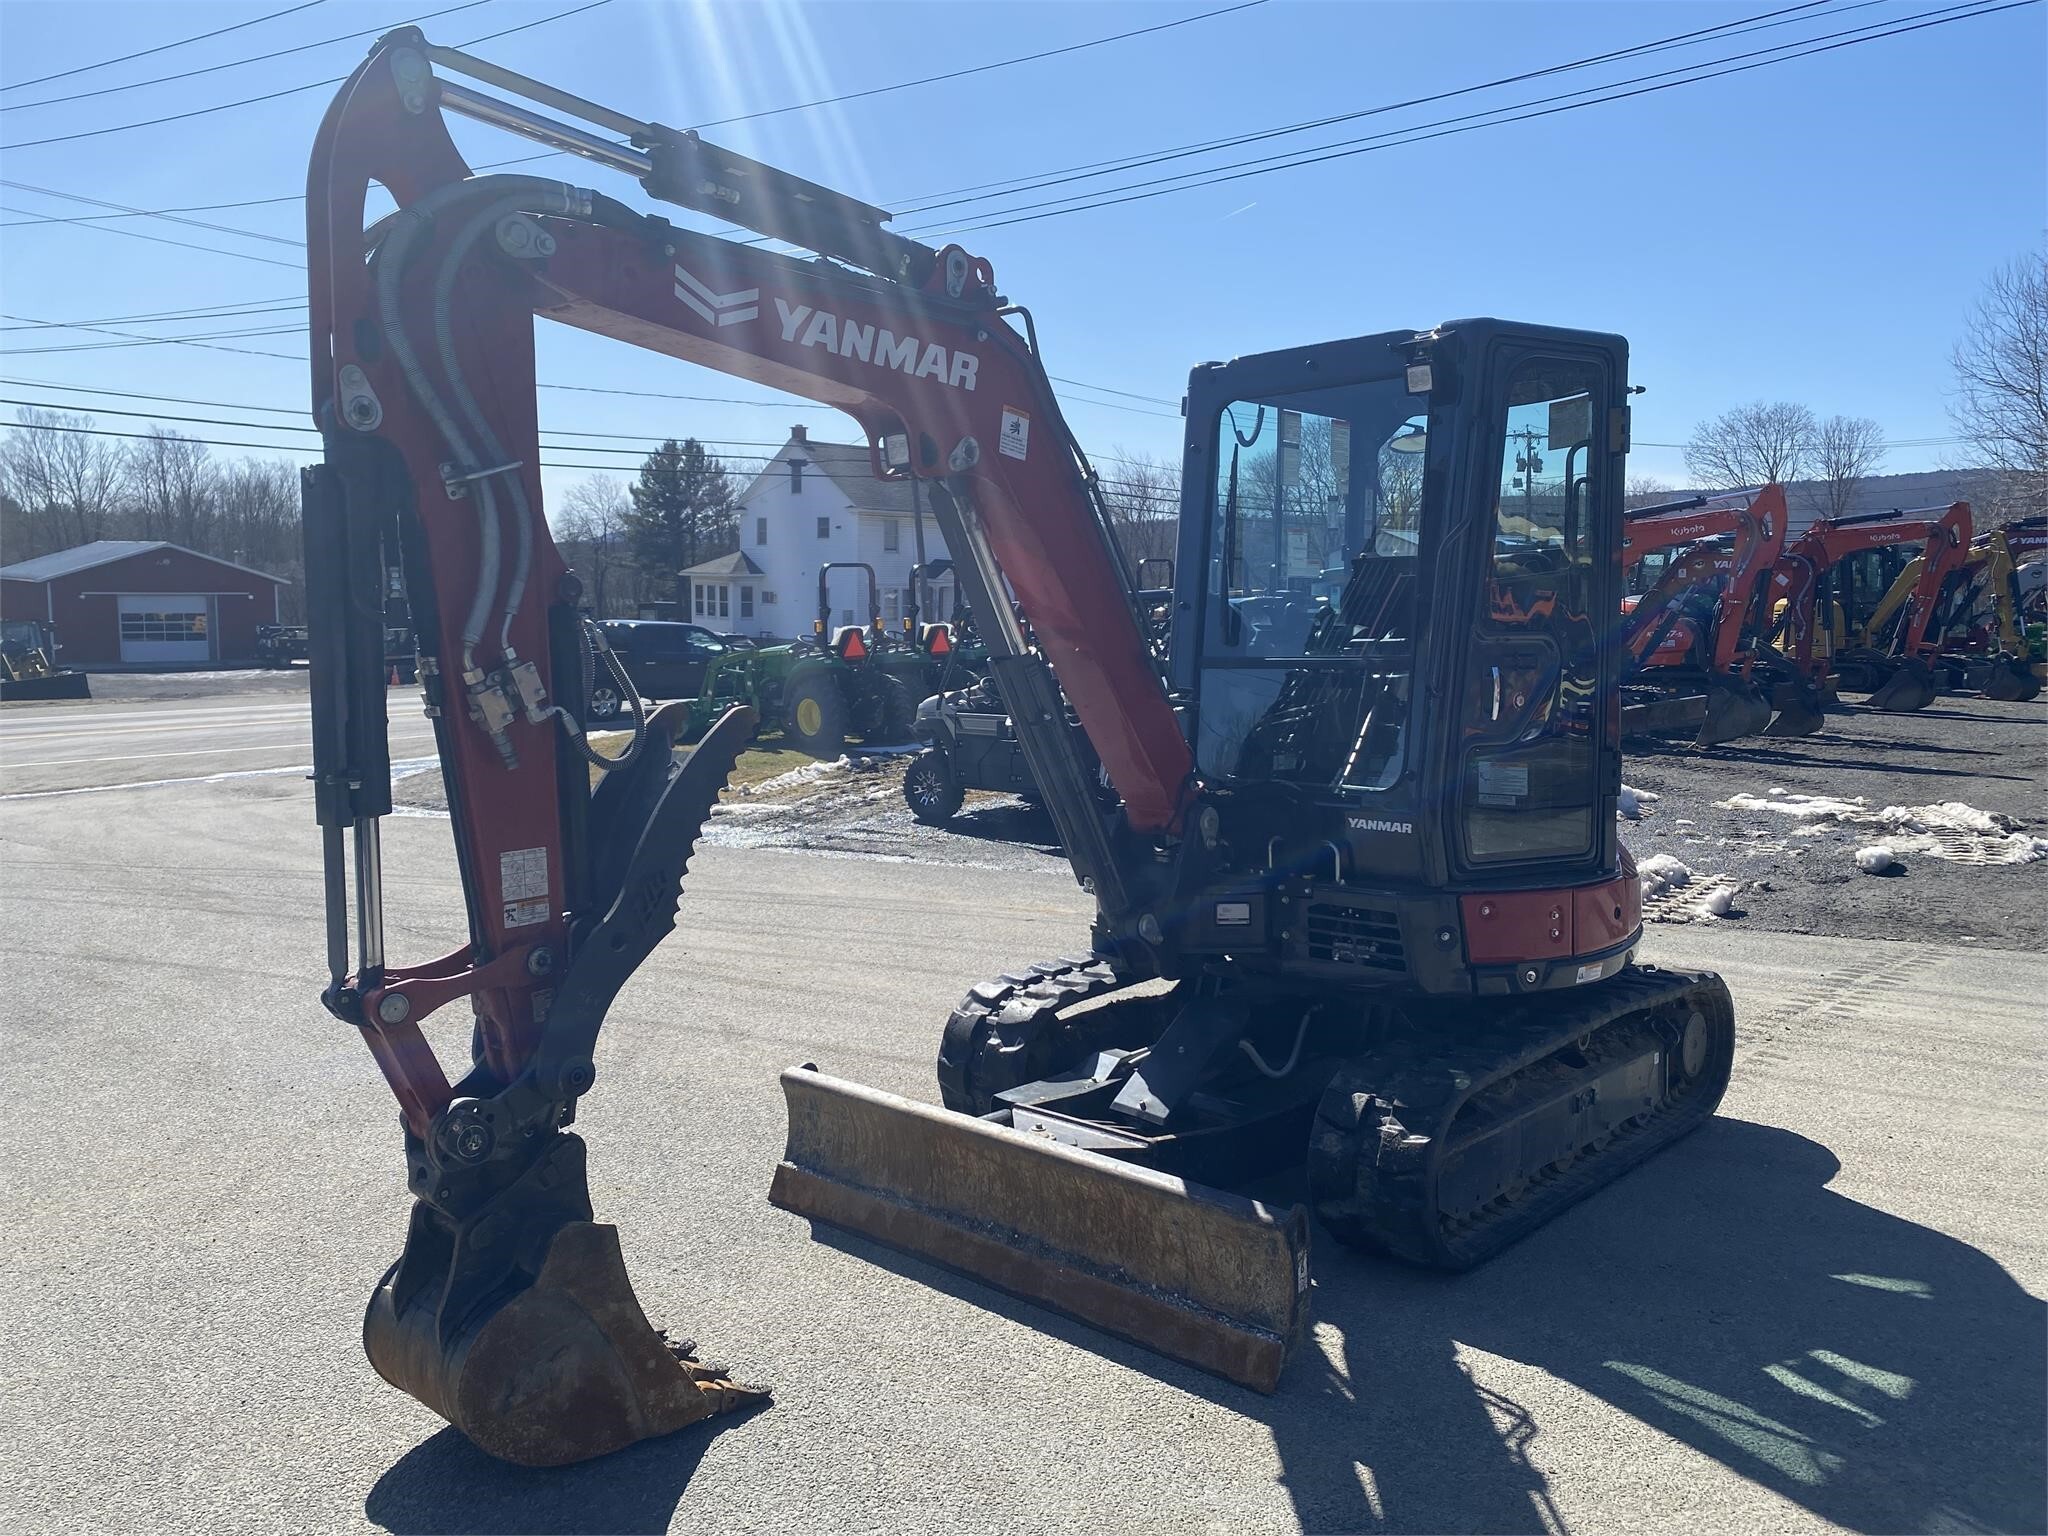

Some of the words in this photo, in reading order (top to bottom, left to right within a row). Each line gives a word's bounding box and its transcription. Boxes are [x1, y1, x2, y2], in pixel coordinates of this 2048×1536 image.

[774, 297, 979, 391] YANMAR
[1671, 524, 1705, 536] Kubota
[1870, 533, 1900, 542] Kubota
[1348, 817, 1412, 834] YANMAR
